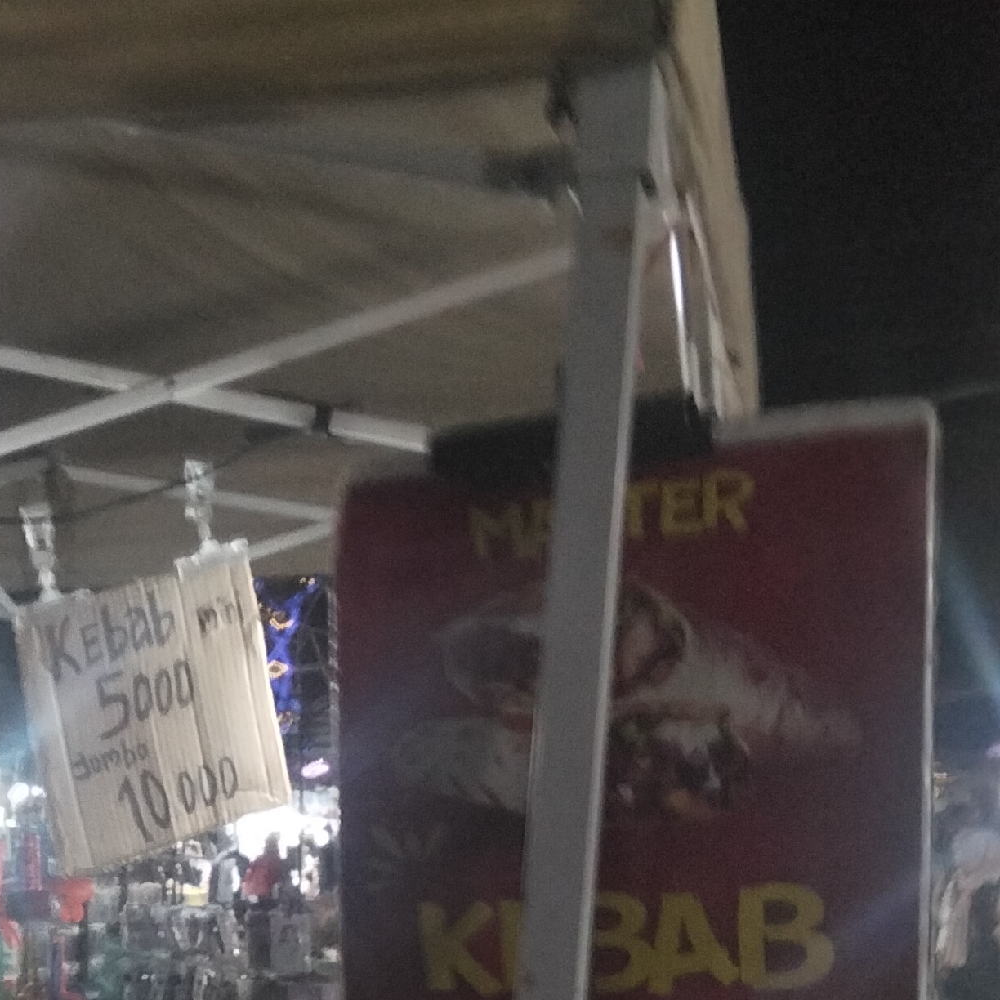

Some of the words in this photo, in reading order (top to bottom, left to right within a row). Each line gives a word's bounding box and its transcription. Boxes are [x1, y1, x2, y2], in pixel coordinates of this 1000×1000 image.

[467, 468, 757, 558] MATER
[95, 658, 194, 740] 5000
[418, 881, 836, 996] KBAB
